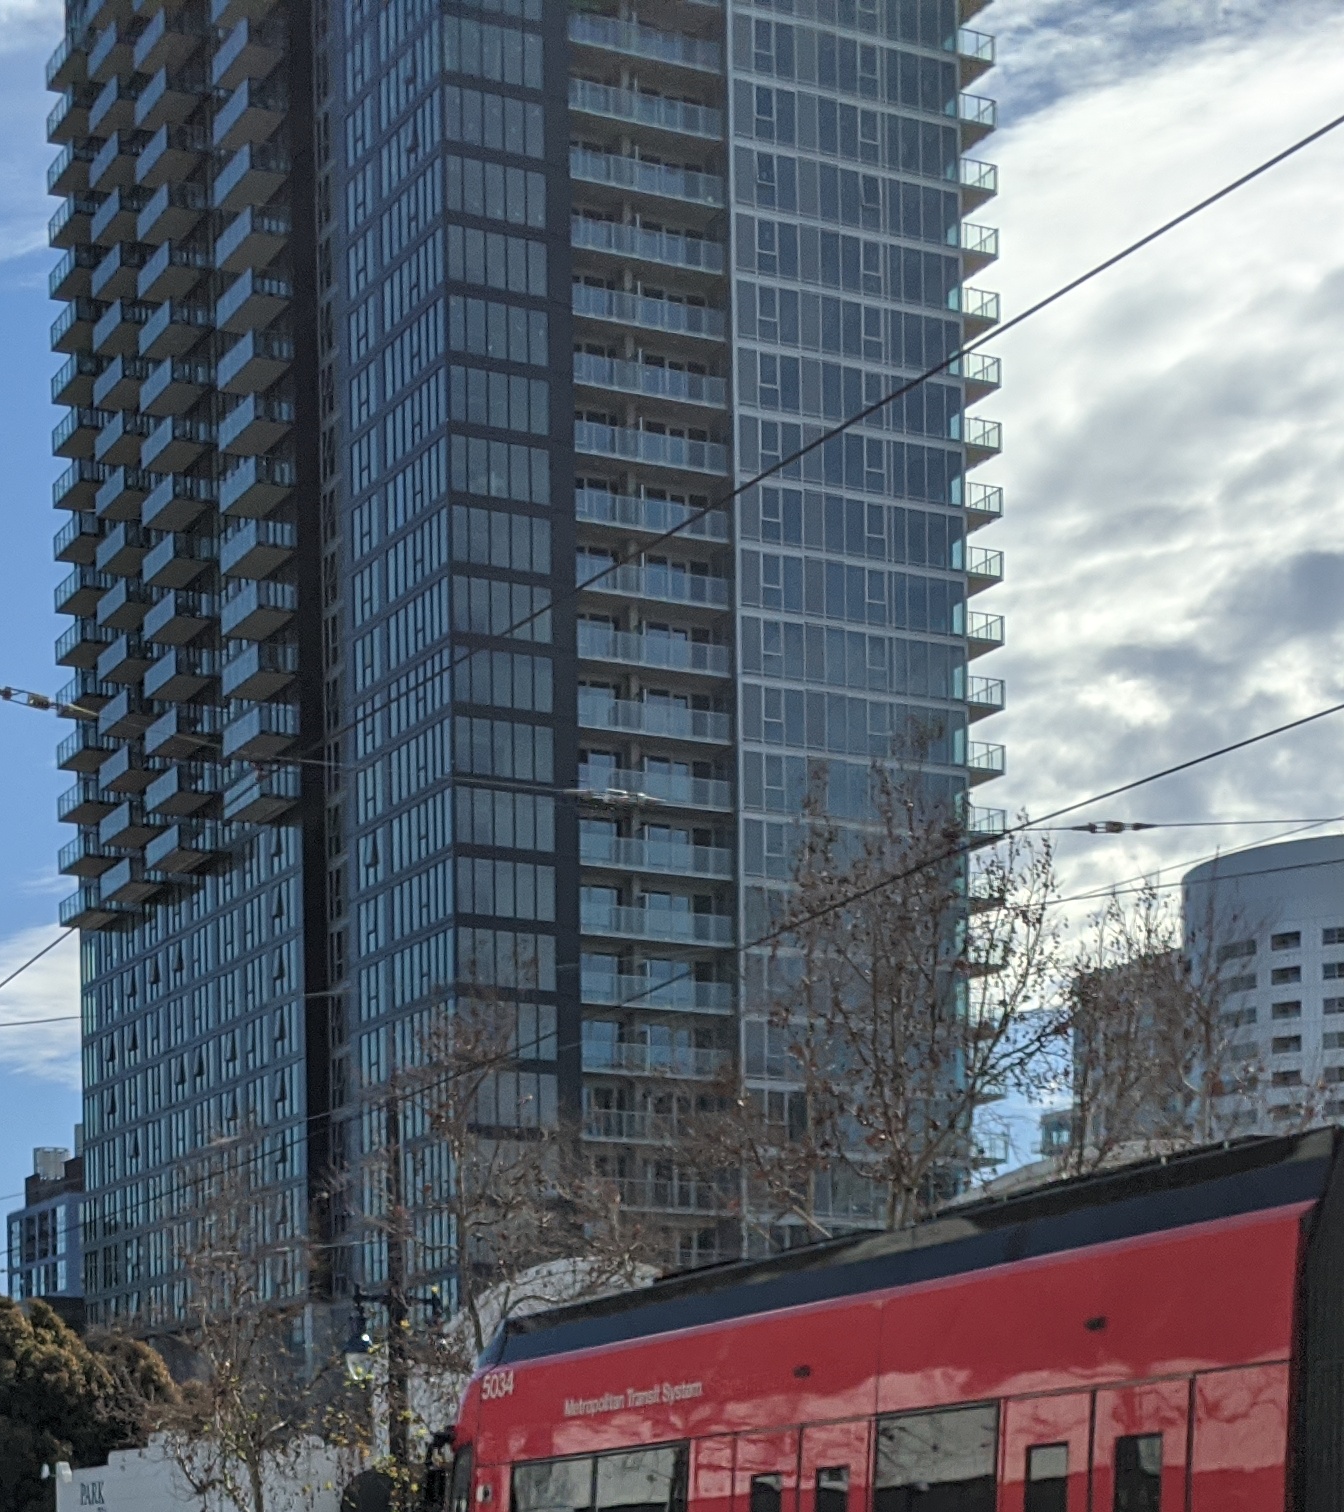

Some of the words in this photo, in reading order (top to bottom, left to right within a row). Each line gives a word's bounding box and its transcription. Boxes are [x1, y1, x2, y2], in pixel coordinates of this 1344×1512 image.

[482, 1371, 514, 1399] 5034
[565, 1393, 624, 1416] Metropolitan
[627, 1385, 660, 1407] Transit
[663, 1381, 703, 1405] System
[80, 1481, 104, 1505] PARK
